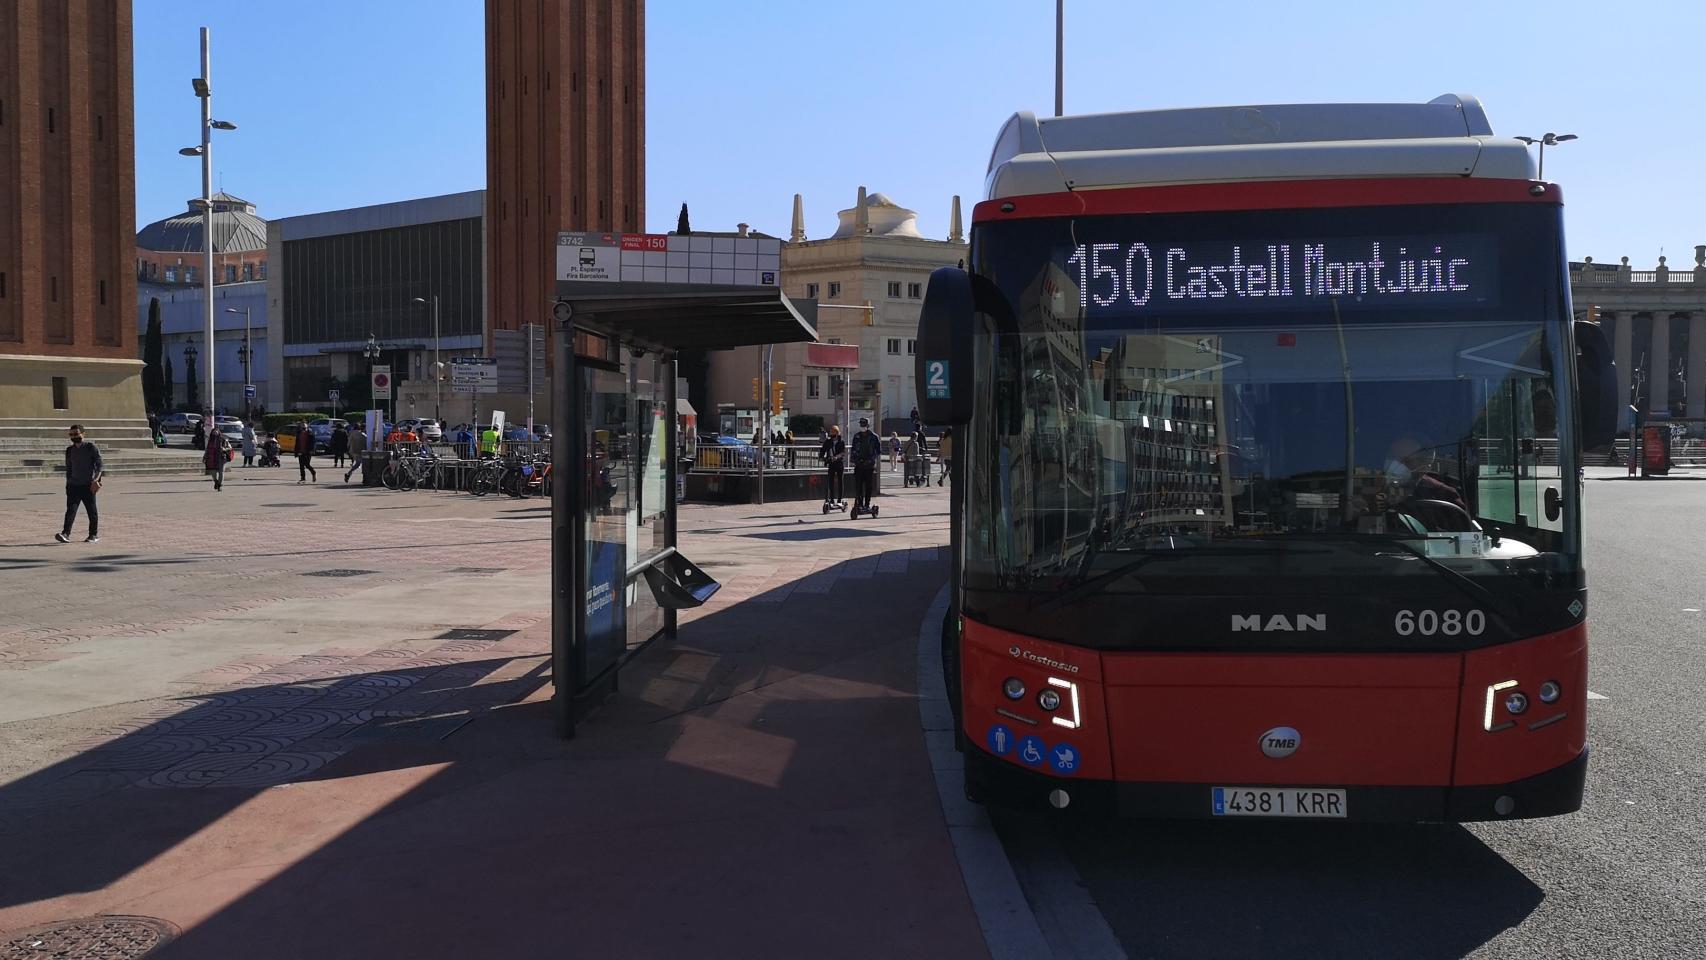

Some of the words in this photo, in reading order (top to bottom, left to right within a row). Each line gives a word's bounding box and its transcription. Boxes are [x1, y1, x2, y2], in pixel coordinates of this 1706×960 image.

[561, 237, 583, 246] 3742
[646, 238, 665, 248] 150
[1067, 242, 1153, 306] 150
[1166, 244, 1293, 299] Castell
[1304, 241, 1470, 296] Montjuic
[930, 362, 944, 384] 2
[1231, 613, 1327, 632] MAN
[1394, 609, 1486, 636] 6080
[1022, 650, 1079, 673] Castrosua
[1267, 737, 1295, 749] TMB
[1229, 790, 1285, 814] 4381
[1296, 791, 1340, 815] KRR
